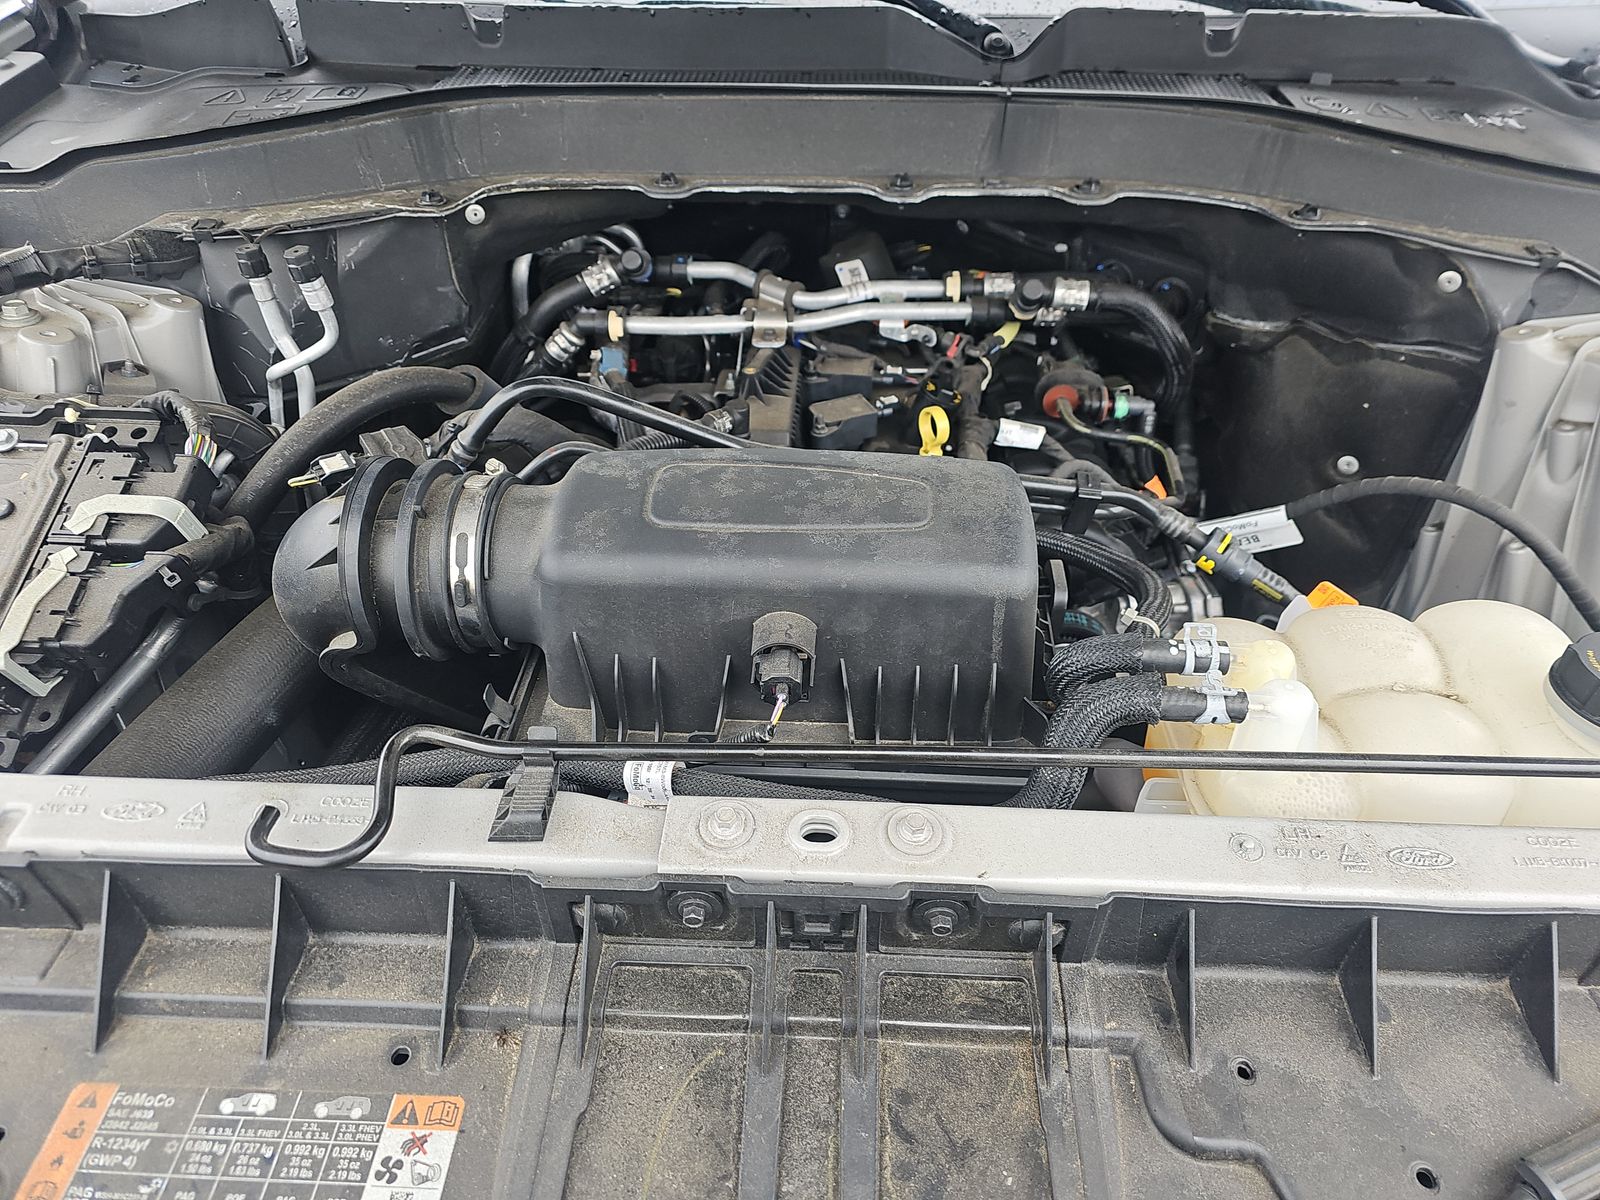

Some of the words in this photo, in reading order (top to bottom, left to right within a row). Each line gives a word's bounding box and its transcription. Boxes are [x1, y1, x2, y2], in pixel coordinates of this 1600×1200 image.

[112, 1091, 175, 1107] FoMoCo
[340, 1124, 357, 1133] 3.3L
[358, 1124, 382, 1134] FHEV
[91, 1137, 151, 1153] R-1234yf
[212, 1141, 227, 1156] kg
[232, 1141, 260, 1155] 0.737
[260, 1143, 274, 1159] kg
[284, 1143, 312, 1156] 0.992
[312, 1145, 326, 1158] kg
[83, 1153, 123, 1168] (GWP
[332, 1146, 359, 1158] 0.992
[360, 1147, 374, 1161] kg
[337, 1158, 350, 1169] 35
[349, 1161, 361, 1170] oz
[279, 1167, 299, 1178] 2.19
[299, 1167, 314, 1178] lbs
[328, 1169, 348, 1180] 2.19
[347, 1170, 362, 1181] lbs
